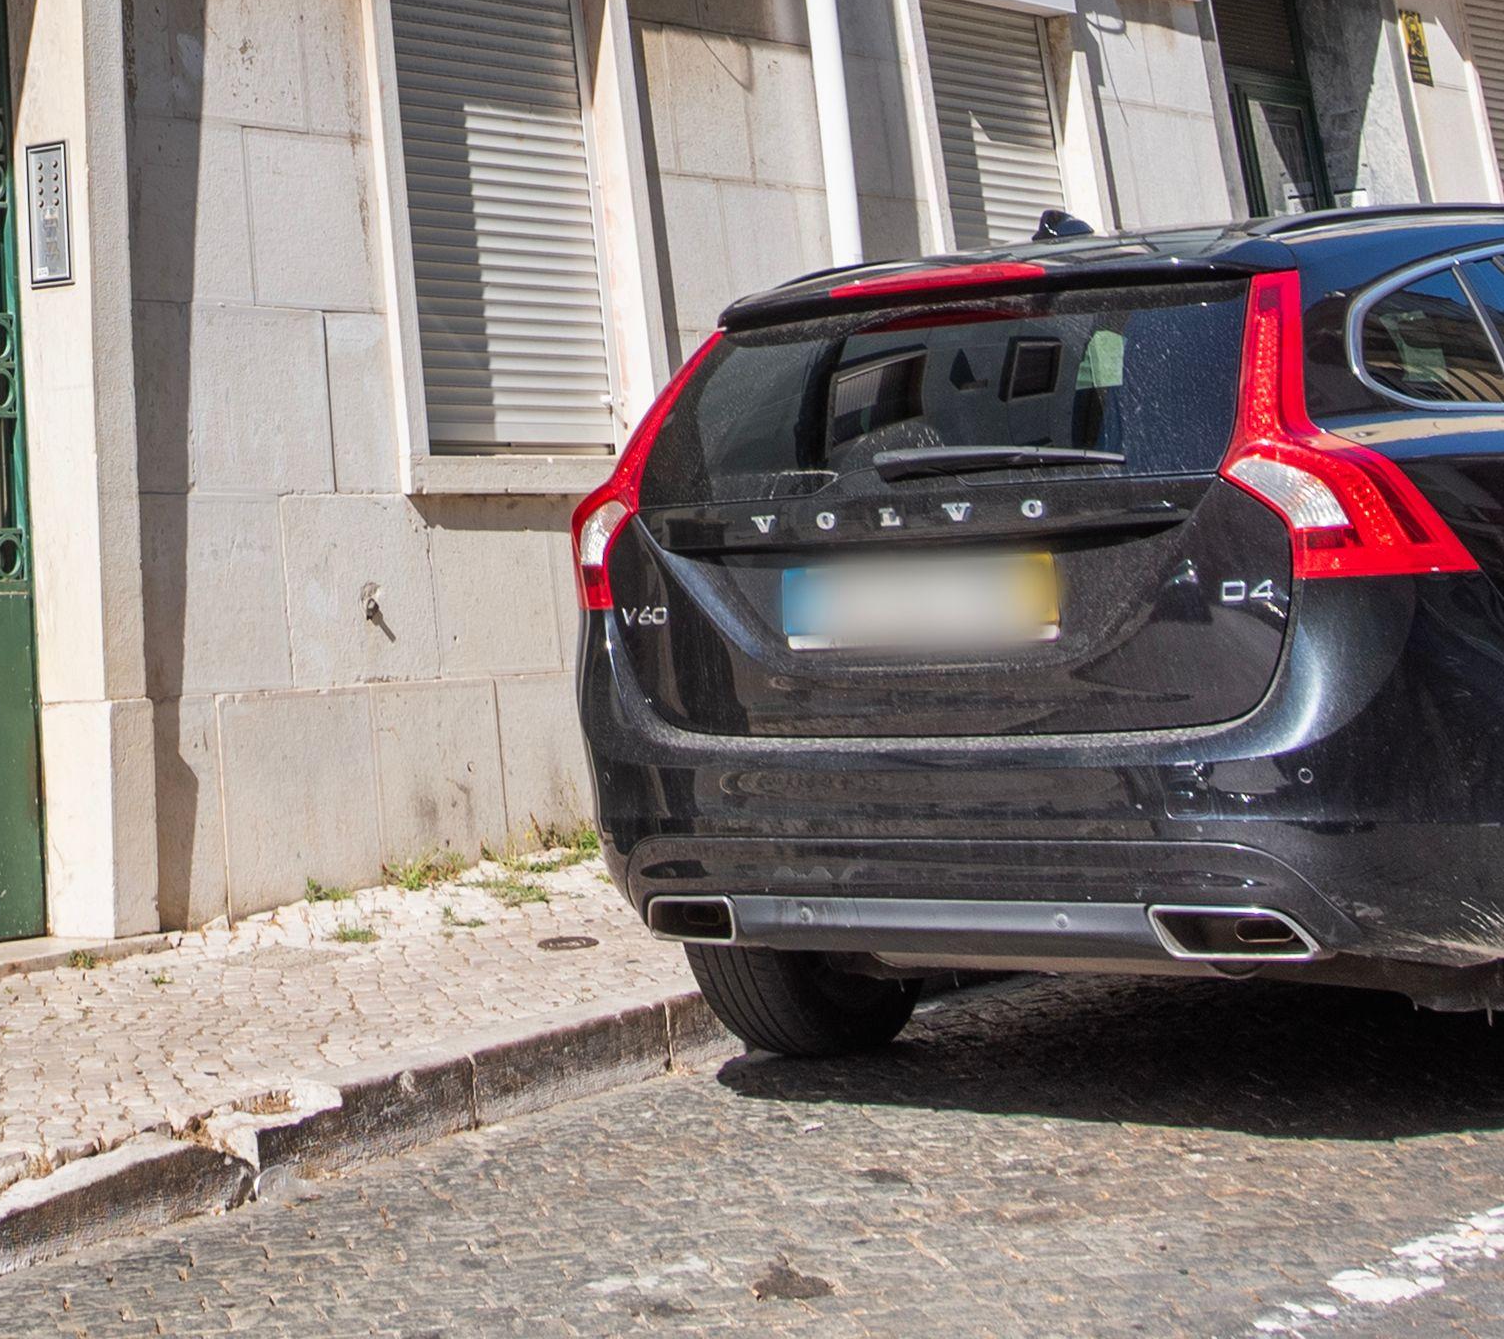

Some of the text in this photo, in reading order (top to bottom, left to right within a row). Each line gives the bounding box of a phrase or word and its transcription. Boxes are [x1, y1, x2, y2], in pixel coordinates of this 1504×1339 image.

[750, 499, 1043, 534] VOLVO
[1221, 579, 1274, 602] D4
[622, 605, 668, 627] V60
